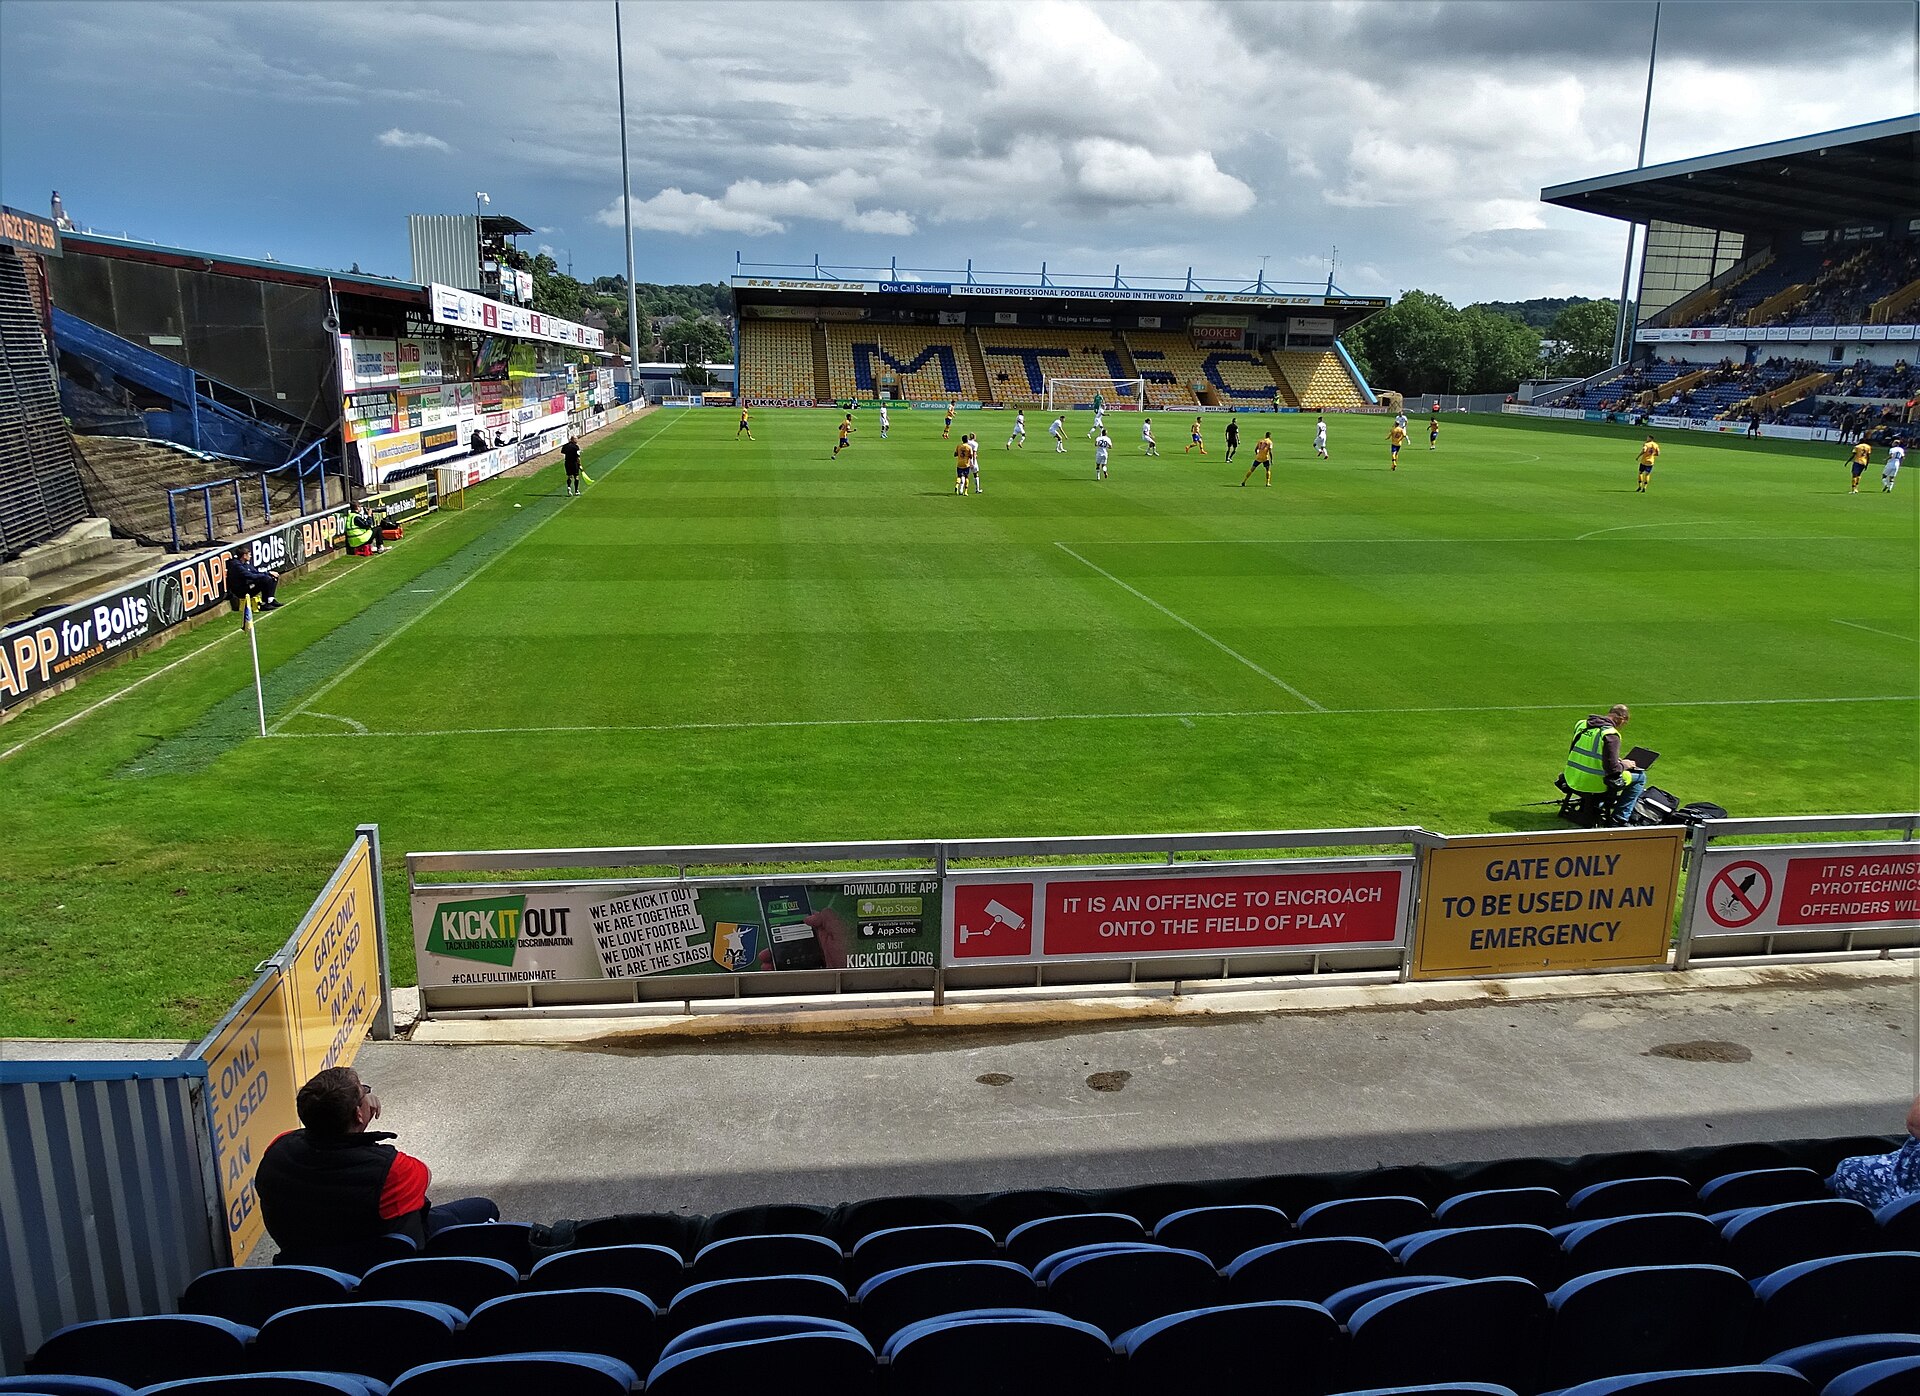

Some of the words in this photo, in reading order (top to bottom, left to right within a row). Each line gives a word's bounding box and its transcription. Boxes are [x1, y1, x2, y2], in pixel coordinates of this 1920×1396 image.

[881, 283, 898, 292] One
[900, 284, 915, 293] Call
[916, 284, 948, 294] Stadium
[960, 286, 973, 294] THE
[975, 286, 1003, 295] OLDEST
[1005, 288, 1058, 297] PROFESSIONAL
[1060, 289, 1097, 298] FOOTBALL
[1098, 291, 1131, 299] GROUND
[1143, 292, 1156, 300] THE
[1193, 328, 1237, 338] BOOKER
[744, 398, 814, 408] PUKKA-PIES
[302, 515, 337, 558] BAPP
[336, 512, 347, 536] fo
[252, 535, 285, 567] Bolts
[0, 626, 59, 697] APP
[62, 619, 92, 656] for
[94, 596, 149, 641] Bolts
[53, 643, 105, 674] www.bapp.co.uk
[1486, 857, 1550, 882] GATE
[1554, 854, 1621, 878] ONLY
[1822, 866, 1837, 878] IT
[1840, 865, 1854, 877] IS
[843, 883, 896, 896] DOWNLOAD
[899, 882, 917, 894] THE
[919, 882, 938, 893] APP
[1063, 897, 1081, 914] IT
[1088, 897, 1106, 913] IS
[1111, 896, 1140, 912] AN
[1145, 892, 1237, 911] OFFENCE
[1243, 891, 1270, 907] TO
[1274, 887, 1382, 906] ENCROACH
[1442, 896, 1476, 918] TO
[1481, 894, 1513, 917] BE
[1517, 890, 1583, 914] USED
[1588, 888, 1614, 910] IN
[1618, 886, 1655, 908] AN
[589, 905, 608, 920] WE
[610, 900, 631, 916] ARE
[632, 894, 658, 911] KICK
[658, 891, 669, 905] IT
[671, 888, 692, 902] OUT
[876, 904, 894, 915] App
[895, 903, 918, 912] Store
[1800, 901, 1890, 917] OFFENDERS
[313, 920, 337, 973] GATE
[336, 888, 357, 938] ONLY
[441, 909, 499, 941] KICK
[498, 909, 519, 939] IT
[524, 907, 570, 938] OUT
[593, 920, 612, 935] WE
[614, 915, 635, 931] ARE
[636, 903, 690, 926] TOGETHER
[877, 927, 895, 936] App
[895, 926, 917, 934] Store
[1099, 920, 1156, 937] ONTO
[1160, 918, 1199, 935] THE
[1205, 916, 1260, 933] FIELD
[1264, 914, 1292, 931] OF
[1295, 912, 1346, 930] PLAY
[445, 939, 480, 950] TACKLING
[481, 938, 509, 949] RACISM
[509, 938, 515, 947] &
[518, 937, 573, 948] DISCRIMINATION
[598, 935, 617, 950] WE
[617, 929, 645, 946] LOVE
[646, 918, 699, 939] FOOTBALL
[876, 942, 886, 950] OR
[887, 941, 904, 950] VISIT
[1470, 920, 1622, 950] EMERGENCY
[602, 950, 620, 965] WE
[621, 943, 652, 961] DON'T
[654, 937, 682, 954] HATE
[606, 965, 624, 978] WE
[627, 960, 648, 975] ARE
[649, 955, 671, 970] THE
[672, 946, 709, 965] STAGS!
[846, 950, 934, 968] KICKITOUT.ORG
[316, 975, 329, 1011] TO
[328, 954, 340, 992] BE
[340, 921, 361, 970] USED
[452, 969, 556, 984] #CALLFULLTIMEONHATE
[331, 999, 341, 1026] IN
[341, 971, 354, 1010] AN
[221, 1029, 261, 1100] ONLY
[227, 1071, 269, 1141] USED
[228, 1136, 251, 1191] AN
